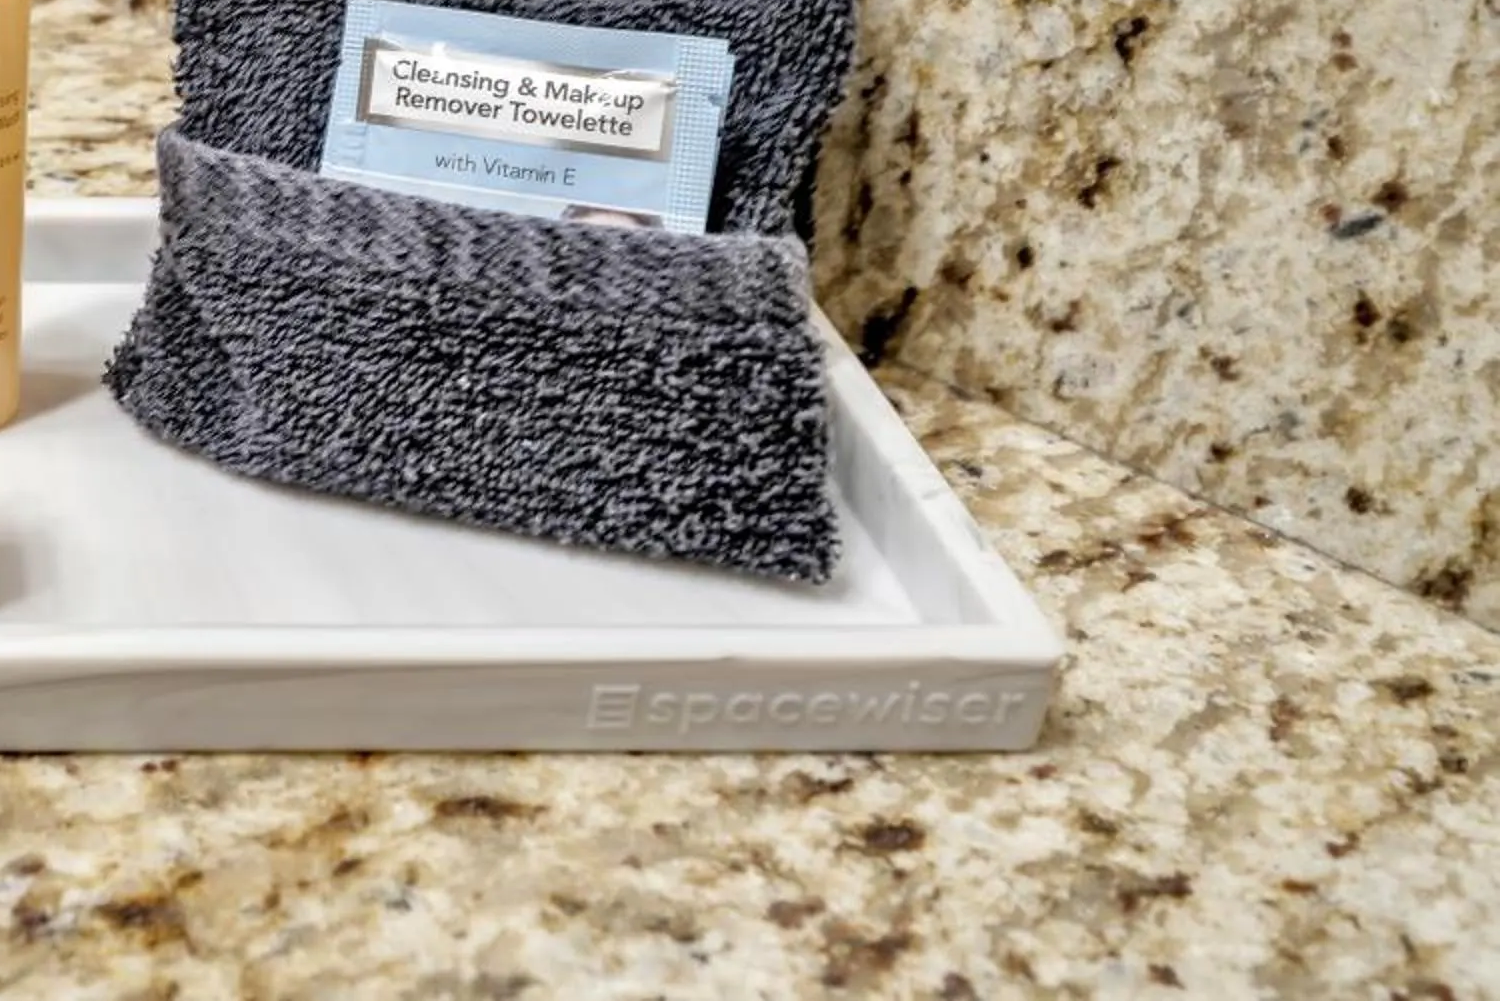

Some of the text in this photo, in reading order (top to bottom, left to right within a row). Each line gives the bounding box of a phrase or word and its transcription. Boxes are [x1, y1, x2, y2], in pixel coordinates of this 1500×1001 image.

[393, 59, 510, 99] Cleansing
[517, 76, 538, 98] &
[395, 86, 633, 137] Remover Towelette
[435, 153, 577, 186] with Vitamin E
[647, 680, 1025, 734] spacewiser
